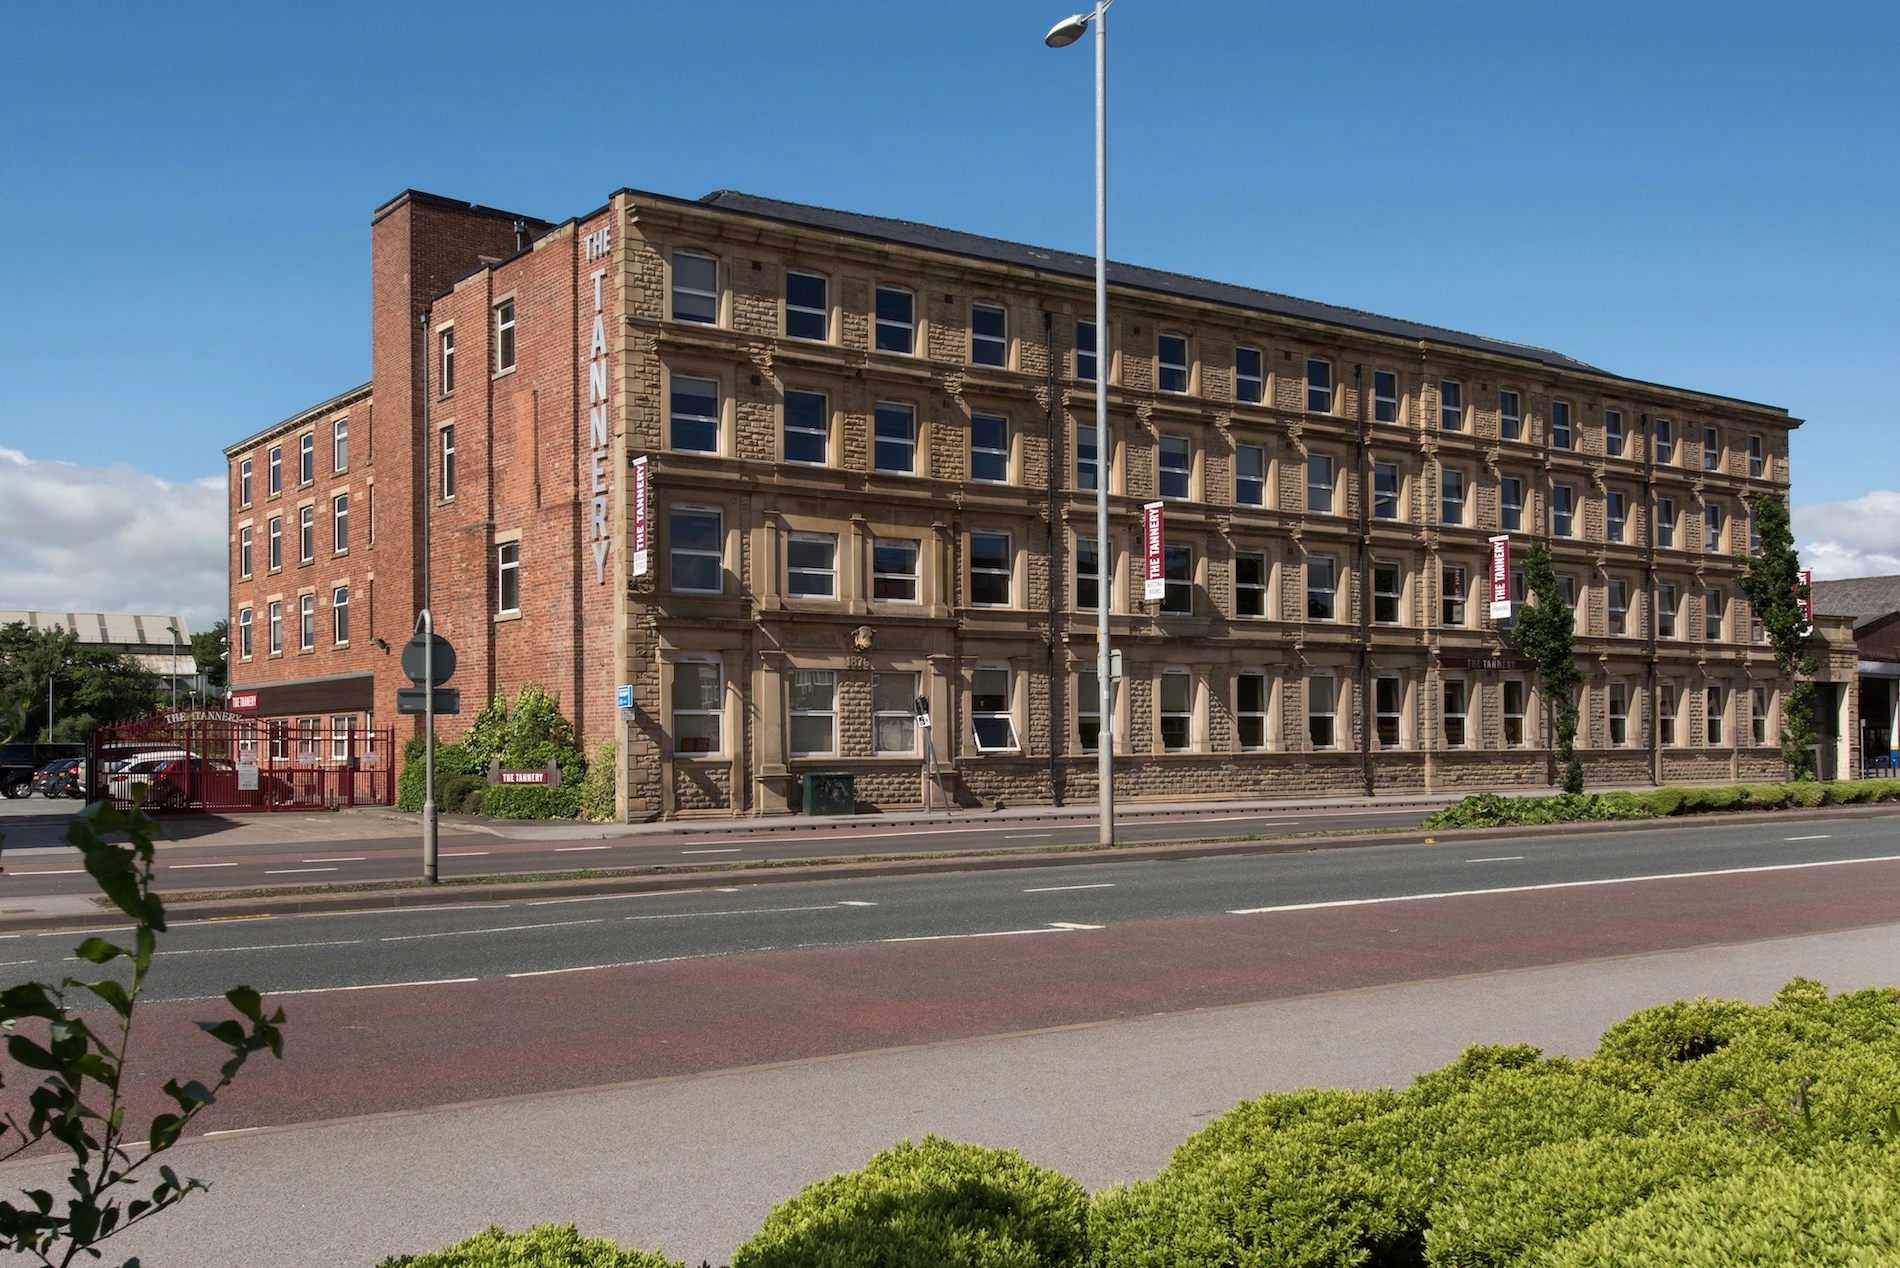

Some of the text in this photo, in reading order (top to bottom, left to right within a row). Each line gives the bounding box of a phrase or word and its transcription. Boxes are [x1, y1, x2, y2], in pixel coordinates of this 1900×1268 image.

[584, 225, 611, 584] THE TANNERY
[636, 465, 645, 551] THE TANNERY
[1149, 508, 1160, 579] THE TANNERY
[1493, 541, 1506, 602] THE TANNERY
[846, 655, 870, 667] 1876
[1467, 659, 1516, 669] THE TANNERY
[164, 711, 242, 724] THE TANNERY
[502, 773, 544, 783] THE TANNERY
